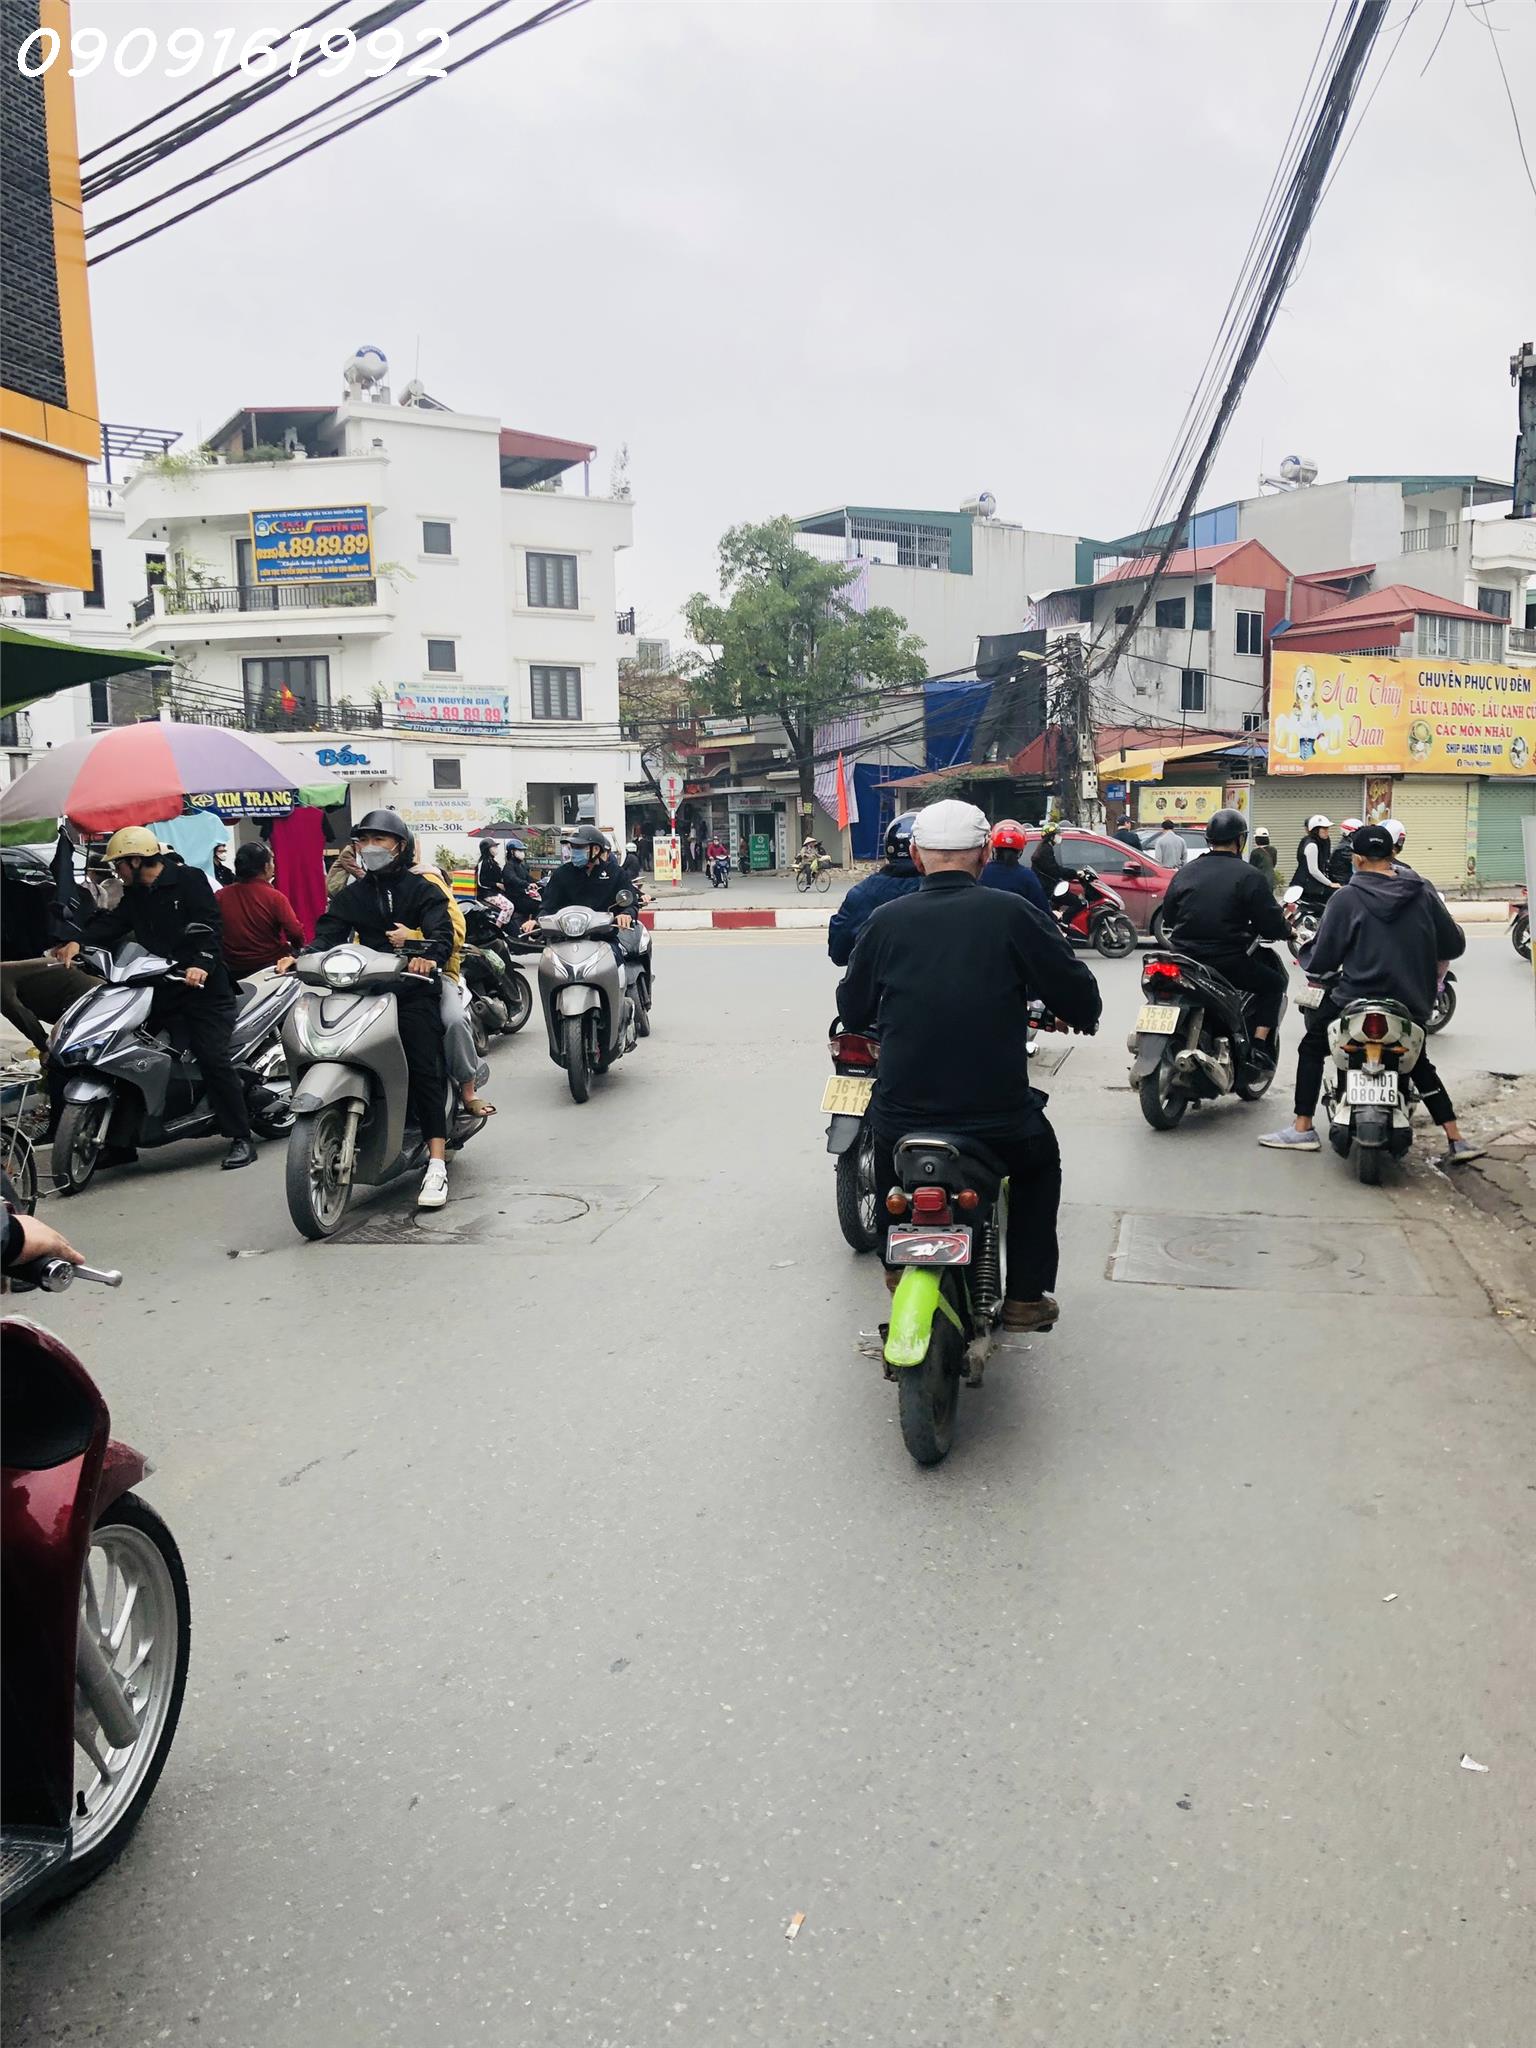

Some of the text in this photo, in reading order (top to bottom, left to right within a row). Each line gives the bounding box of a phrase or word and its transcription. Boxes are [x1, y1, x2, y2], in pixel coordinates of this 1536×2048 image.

[1418, 669, 1531, 695] CHUYÊN PHỤC VỤ ĐÊM
[415, 696, 435, 704] TAXI
[475, 697, 490, 705] GIA
[1321, 672, 1359, 711] Mai
[1430, 701, 1449, 716] CUA
[1501, 704, 1525, 719] CANH
[1435, 721, 1513, 741] CÁC MÓN NHẬU
[215, 791, 292, 808] KIM TRANG
[1350, 1088, 1396, 1103] 080.46
